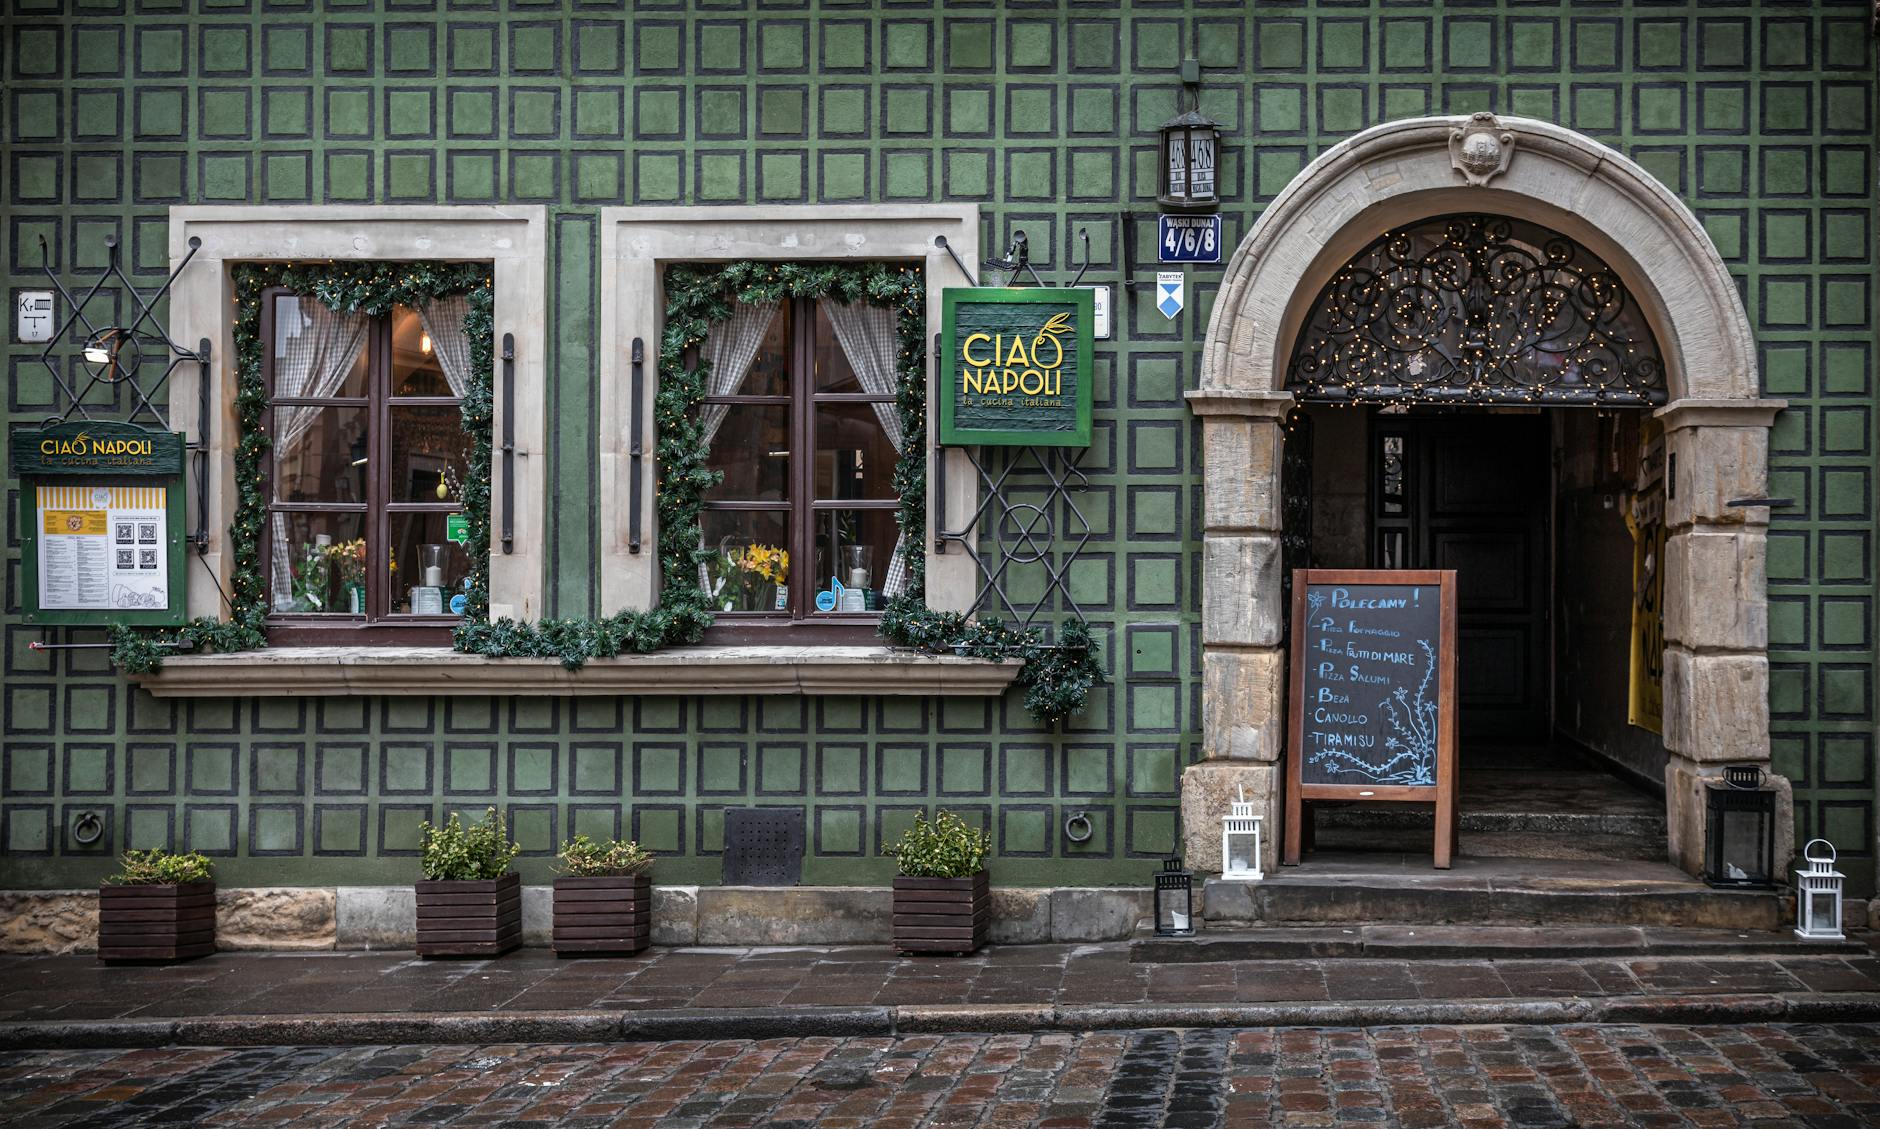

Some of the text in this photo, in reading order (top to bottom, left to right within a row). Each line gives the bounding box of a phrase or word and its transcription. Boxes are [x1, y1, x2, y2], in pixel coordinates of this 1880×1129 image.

[1166, 218, 1214, 229] WĄSKI DUNAJ
[1165, 228, 1215, 257] 4/6/8
[19, 298, 33, 312] Kr
[962, 332, 1063, 369] CIAO
[963, 368, 1062, 396] NAPOLI
[962, 396, 1062, 407] la cucina italiana
[40, 439, 152, 456] CIAO NAPOLI
[41, 455, 153, 466] la cucina italiana
[1331, 588, 1407, 609] POLECAMY
[1384, 651, 1415, 666] MARE
[1318, 662, 1391, 685] PIZZA SALUMI
[1312, 731, 1375, 747] TIRAMISU
